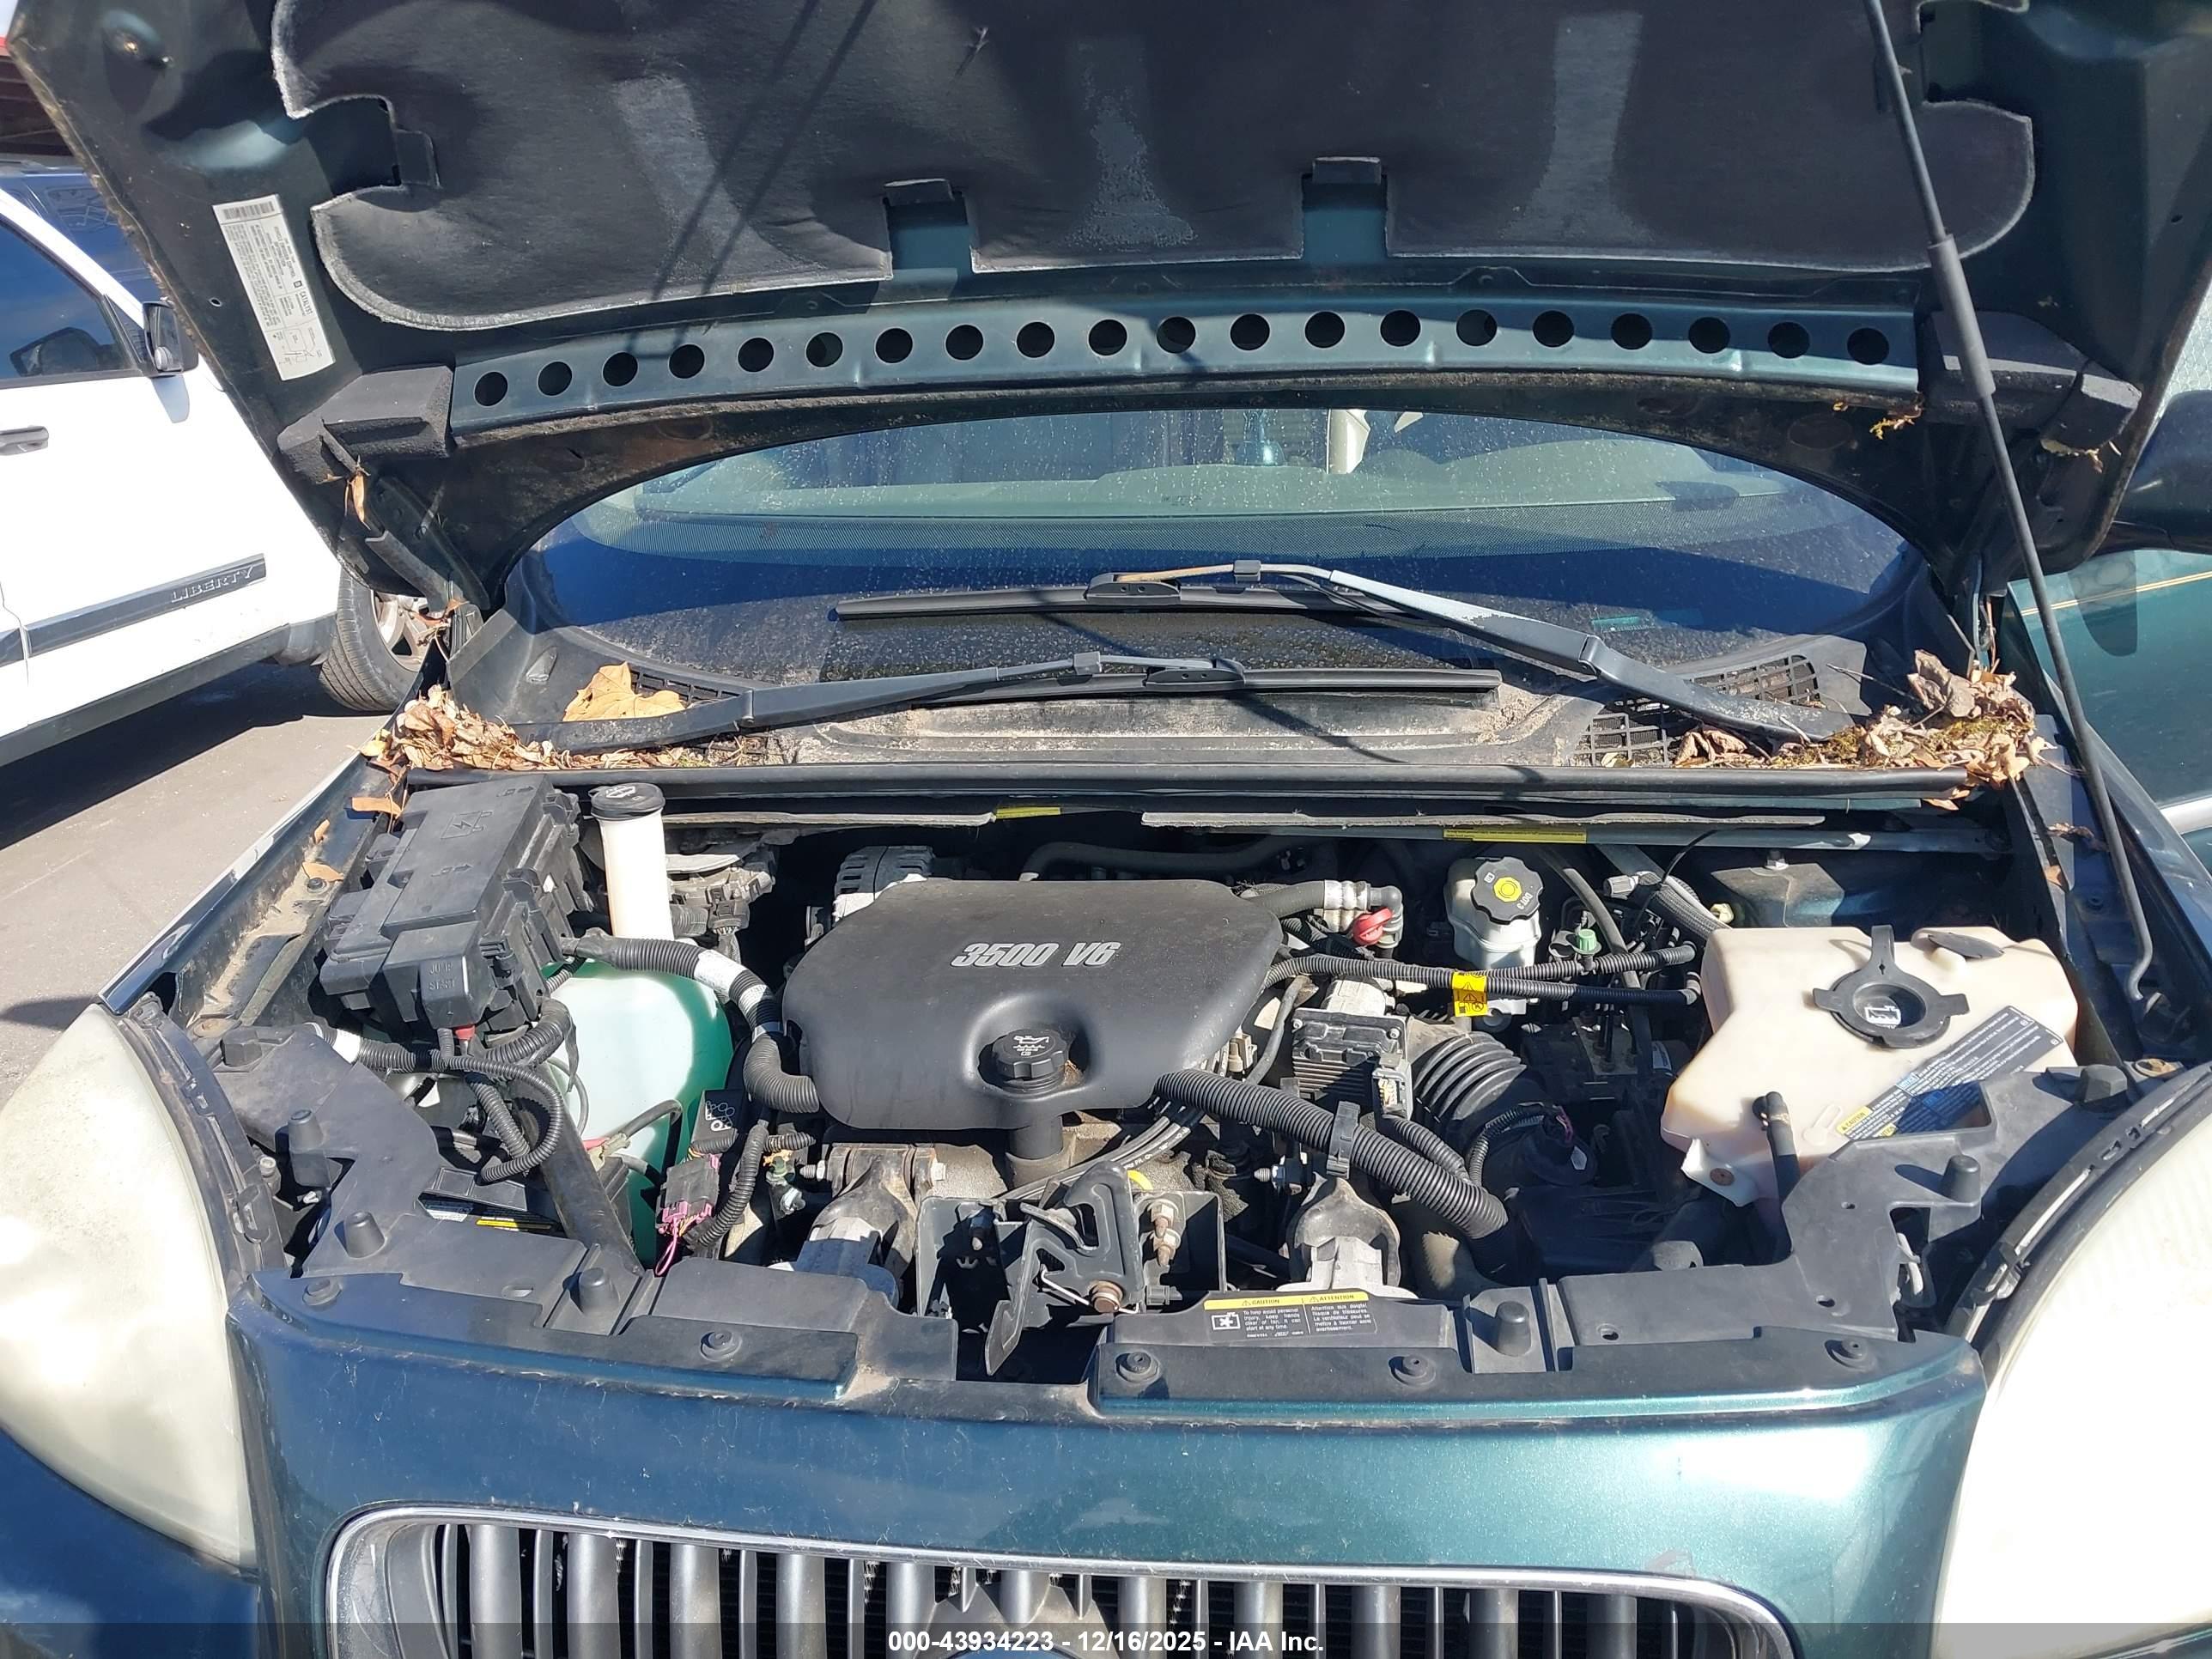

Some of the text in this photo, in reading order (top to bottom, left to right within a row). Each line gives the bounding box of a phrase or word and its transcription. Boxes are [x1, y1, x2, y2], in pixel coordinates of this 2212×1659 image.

[299, 290, 313, 314] CATALYST
[171, 566, 253, 603] LIBERTY
[951, 942, 1121, 967] 3500 V6
[1844, 1111, 1865, 1127] CAUTION
